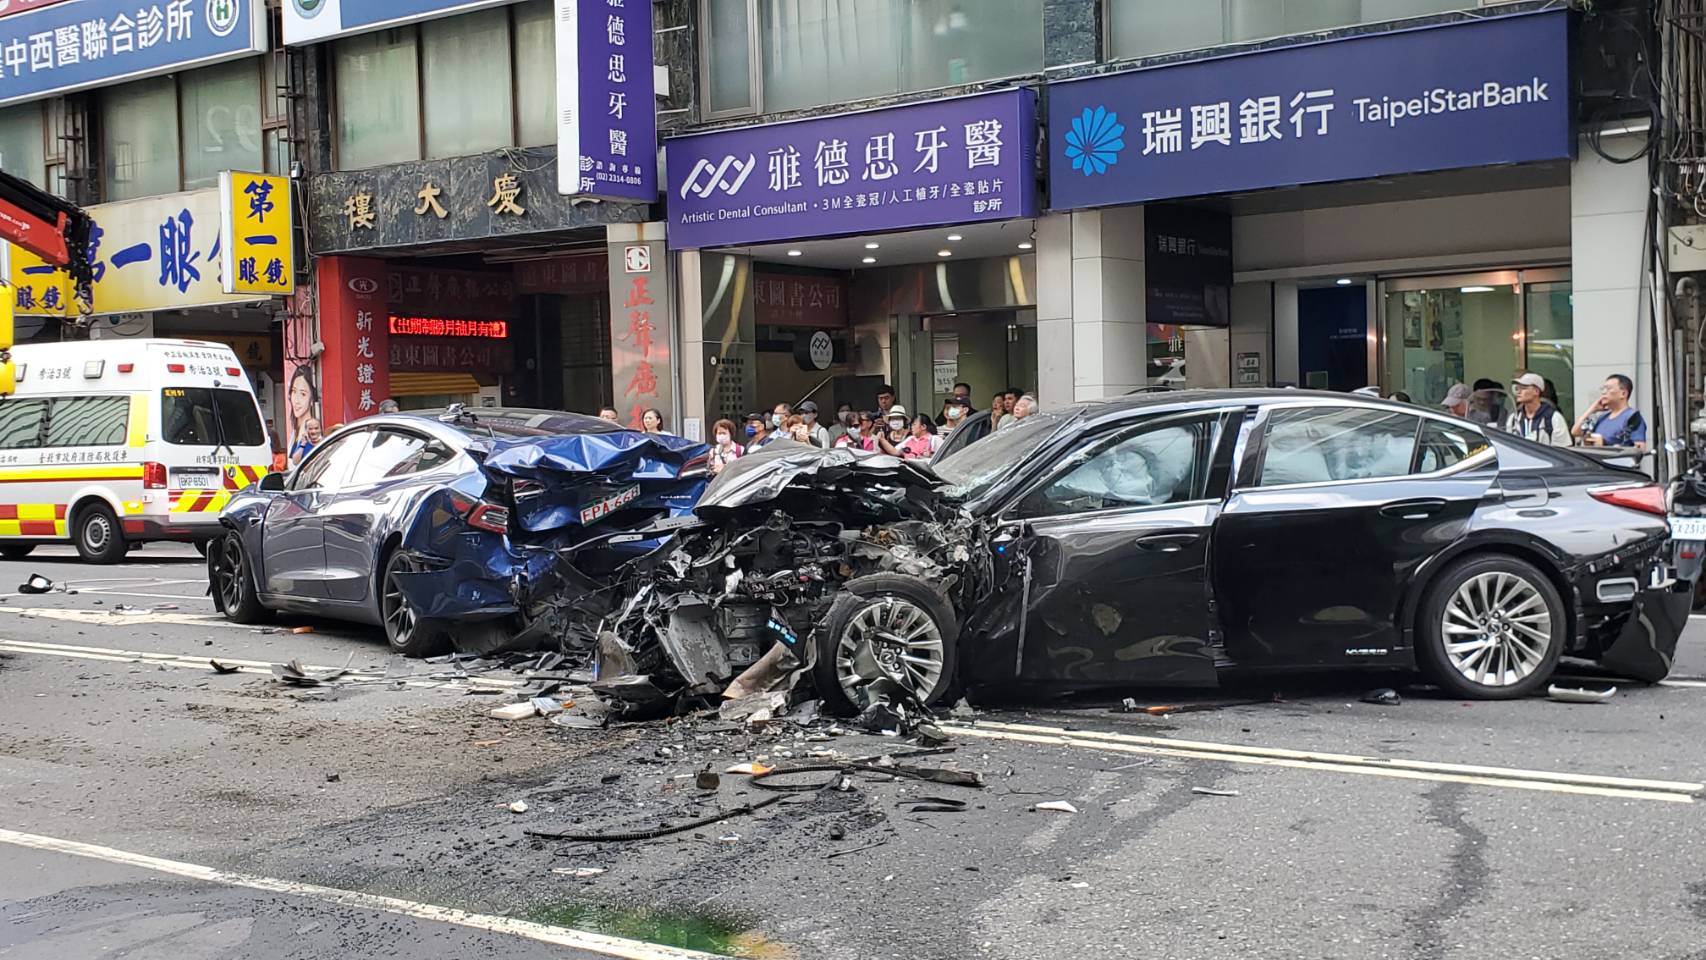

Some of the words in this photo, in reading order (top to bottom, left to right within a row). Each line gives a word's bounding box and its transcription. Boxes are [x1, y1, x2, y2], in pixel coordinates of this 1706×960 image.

[0, 0, 193, 79] 中西醫聯合診所
[606, 0, 628, 157] 德思牙醫
[1142, 88, 1335, 157] 瑞興銀行
[1353, 78, 1548, 126] TaipeiStarBank
[580, 155, 596, 193] 診所
[596, 172, 608, 181] (02)
[767, 119, 1003, 192] 雅德思牙醫
[681, 211, 715, 224] Artistic
[718, 205, 751, 220] Dental
[754, 201, 807, 217] Consultant
[973, 198, 1003, 213] 診所
[74, 207, 221, 304] 一眼
[1158, 235, 1196, 256] 瑞興銀行
[238, 257, 287, 286] 眼鏡
[16, 285, 65, 311] 眼鏡
[355, 310, 377, 412] 新光證券
